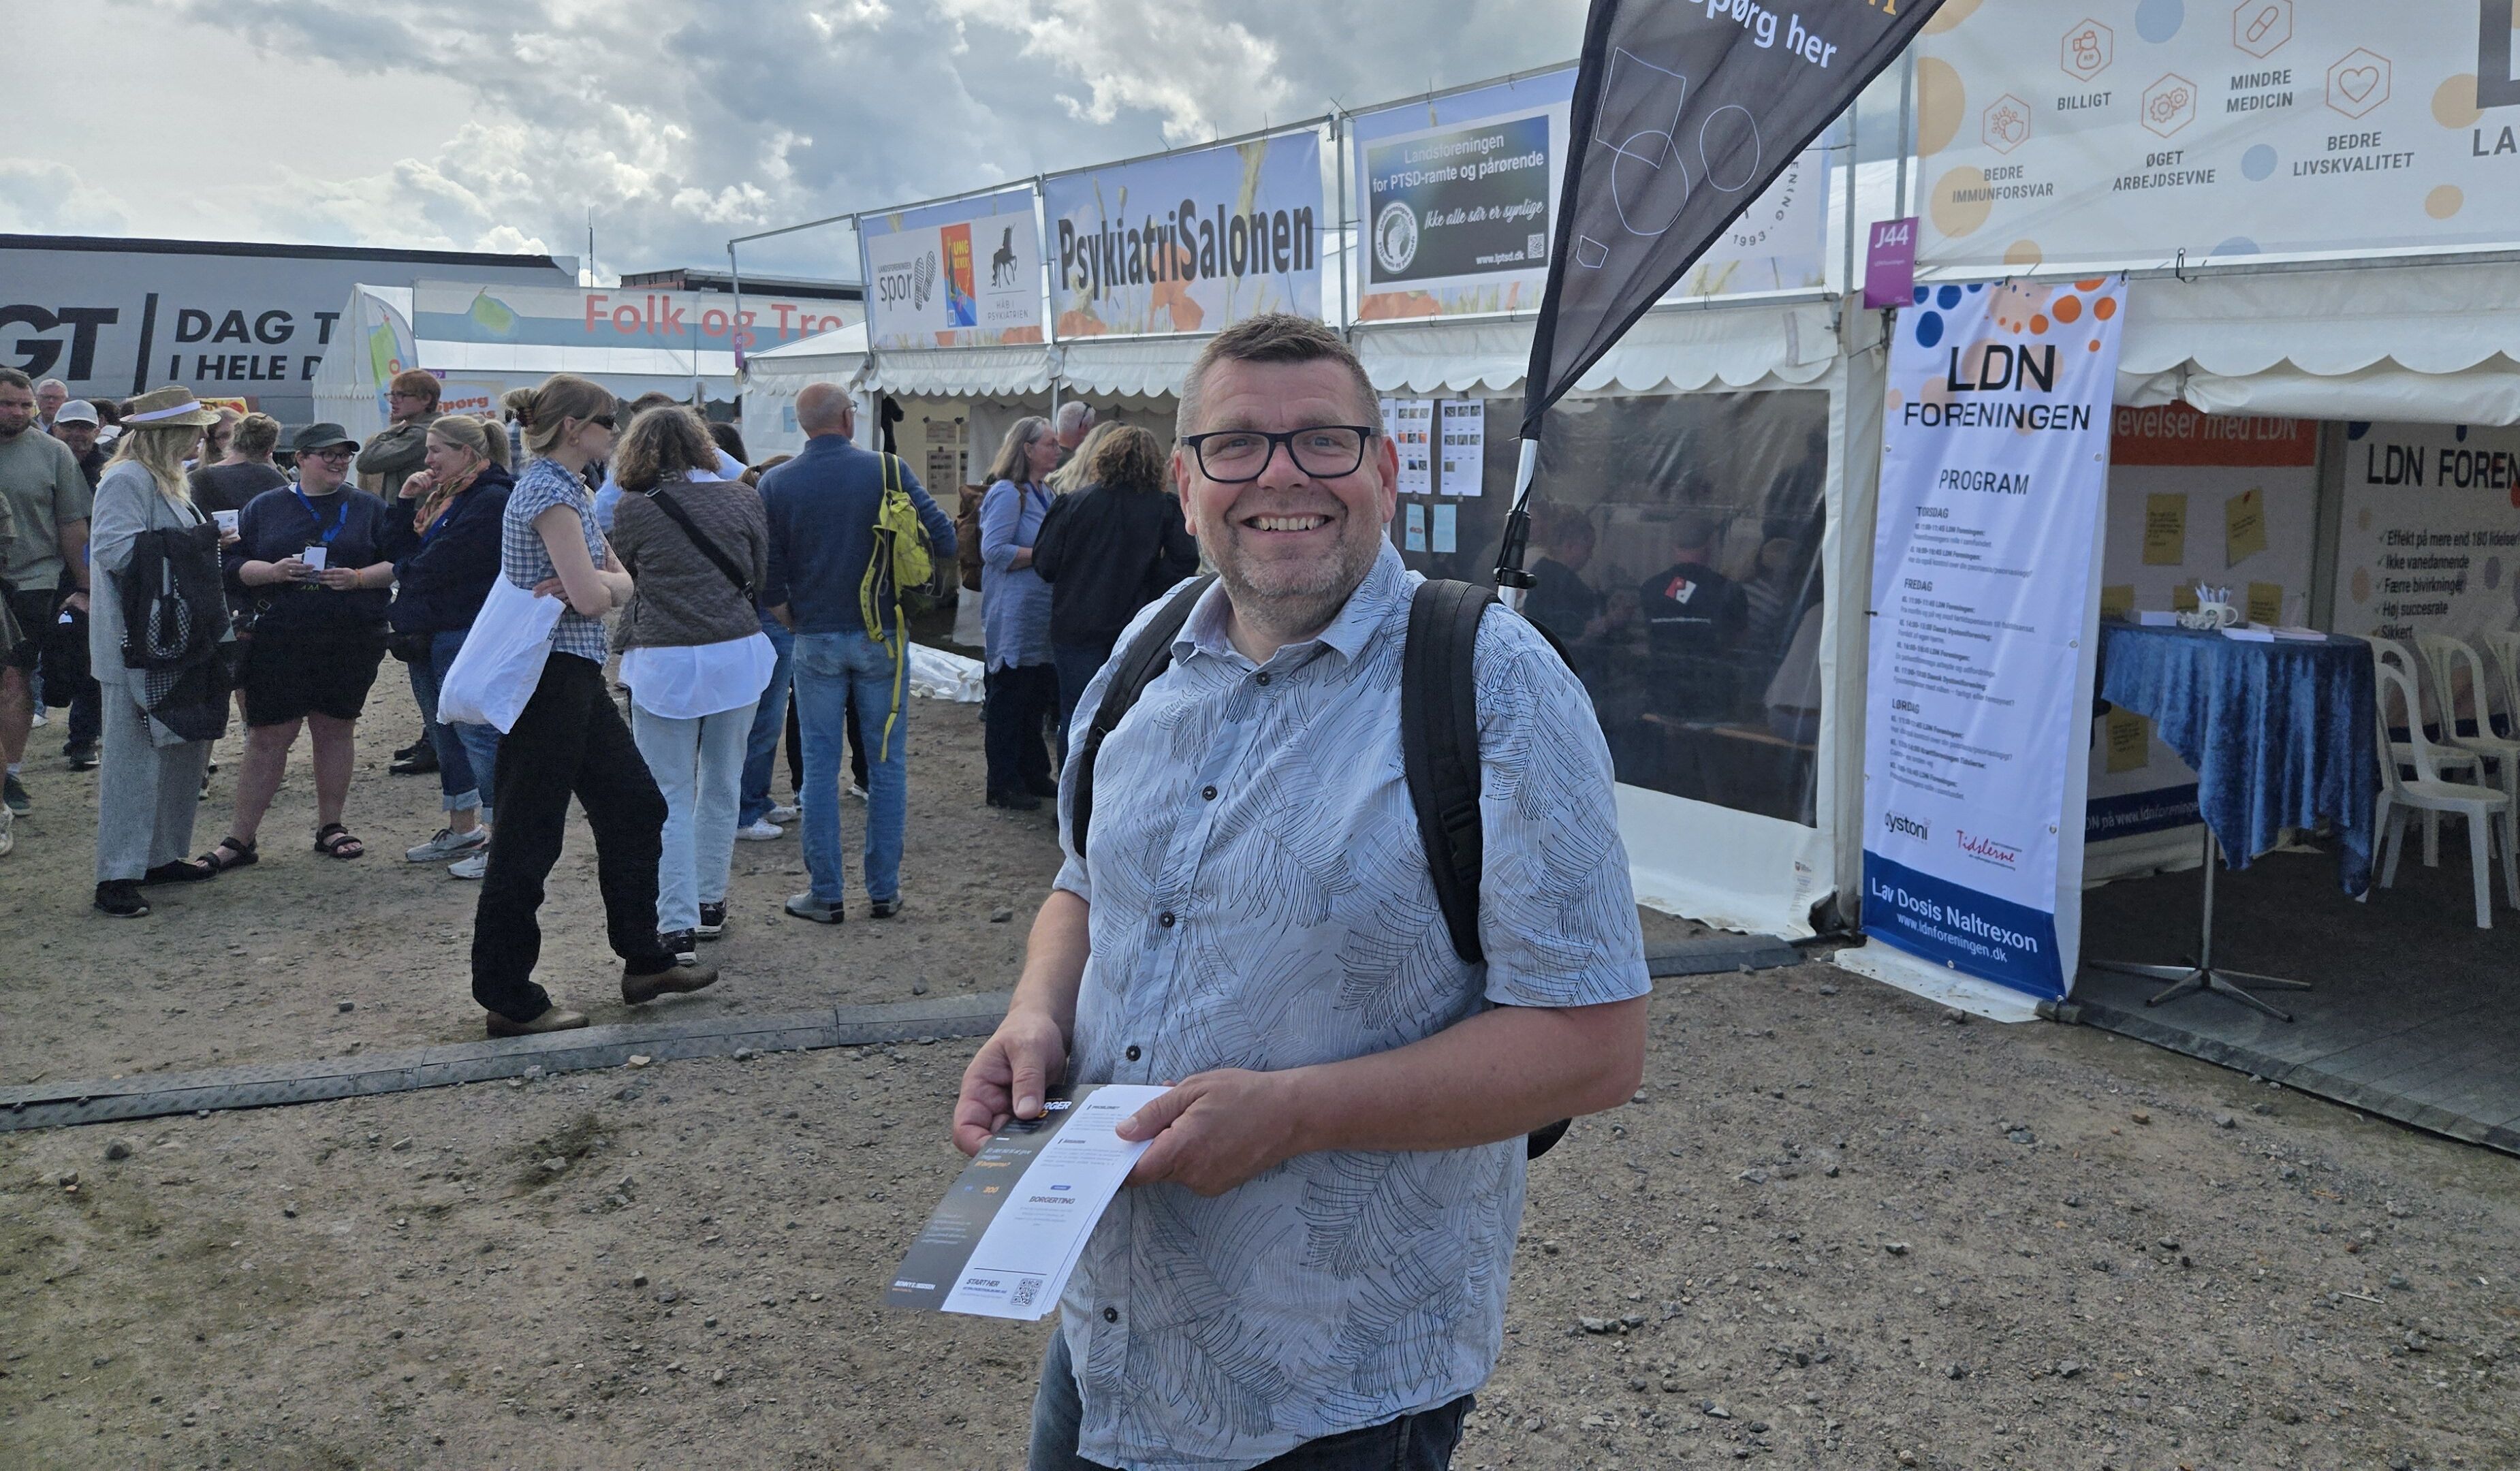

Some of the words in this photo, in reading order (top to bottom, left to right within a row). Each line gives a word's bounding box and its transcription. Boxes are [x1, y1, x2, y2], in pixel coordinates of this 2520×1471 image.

[1689, 0, 1778, 48] pørg
[1786, 14, 1838, 68] her
[2231, 69, 2292, 91] MINDRE
[2057, 92, 2111, 111] BILLIGT
[2226, 91, 2293, 113] MEDICIN
[1404, 135, 1505, 164] Landsforeningen
[2327, 131, 2382, 151] BEDRE
[2472, 125, 2520, 157] LA
[2146, 151, 2184, 168] ØGET
[2293, 152, 2415, 176] LIVSKVALITET
[1372, 178, 1388, 193] for
[1391, 168, 1457, 190] PTSD-ramte
[1460, 165, 1476, 181] og
[1479, 151, 1544, 180] pårørende
[1984, 165, 2024, 182] BEDRE
[2113, 169, 2216, 191] ARBEJDSEVNE
[1952, 183, 2054, 203] IMMUNFORSVAR
[1423, 210, 1445, 230] Ikke
[1446, 210, 1466, 225] alle
[1468, 206, 1487, 223] sår
[1489, 205, 1500, 220] er
[1503, 198, 1544, 223] synlige
[954, 240, 969, 255] UNG
[1732, 230, 1766, 248] 1993
[1874, 225, 1908, 249] J44
[1058, 198, 1314, 301] PsykiatriSalonen
[1476, 250, 1524, 266] www.lptsd.dk
[880, 272, 913, 311] spor
[988, 310, 1029, 321] PSYKIATRIEN
[996, 300, 1010, 310] HÅB
[175, 309, 295, 345] DAG
[585, 294, 686, 335] Folk
[702, 309, 757, 348] og
[169, 354, 181, 381] I
[195, 354, 287, 381] HELE
[1947, 344, 2056, 393] LDN
[1904, 402, 2091, 431] FORENINGEN
[2256, 416, 2297, 441] LDN
[2367, 443, 2425, 487] LDN
[2438, 448, 2520, 490] FOREN
[1938, 469, 2030, 495] PROGRAM
[1916, 506, 1949, 519] TORSDAG
[2387, 529, 2415, 546] Effekt
[2416, 527, 2428, 549] på
[2429, 532, 2452, 546] mere
[2453, 531, 2470, 546] end
[2386, 553, 2406, 570] Ikke
[2407, 553, 2470, 570] vanedannende
[1904, 578, 1933, 592] FREDAG
[1956, 829, 2015, 863] Tidslerne
[1872, 877, 1895, 903] Lav
[1897, 887, 1942, 921] Dosis
[1947, 906, 2038, 953] Naltrexon
[1896, 913, 2009, 963] www.ldnforeningen.dk
[1028, 1196, 1076, 1205] BORGERTING
[966, 1278, 987, 1286] START
[986, 1280, 1001, 1288] HER
